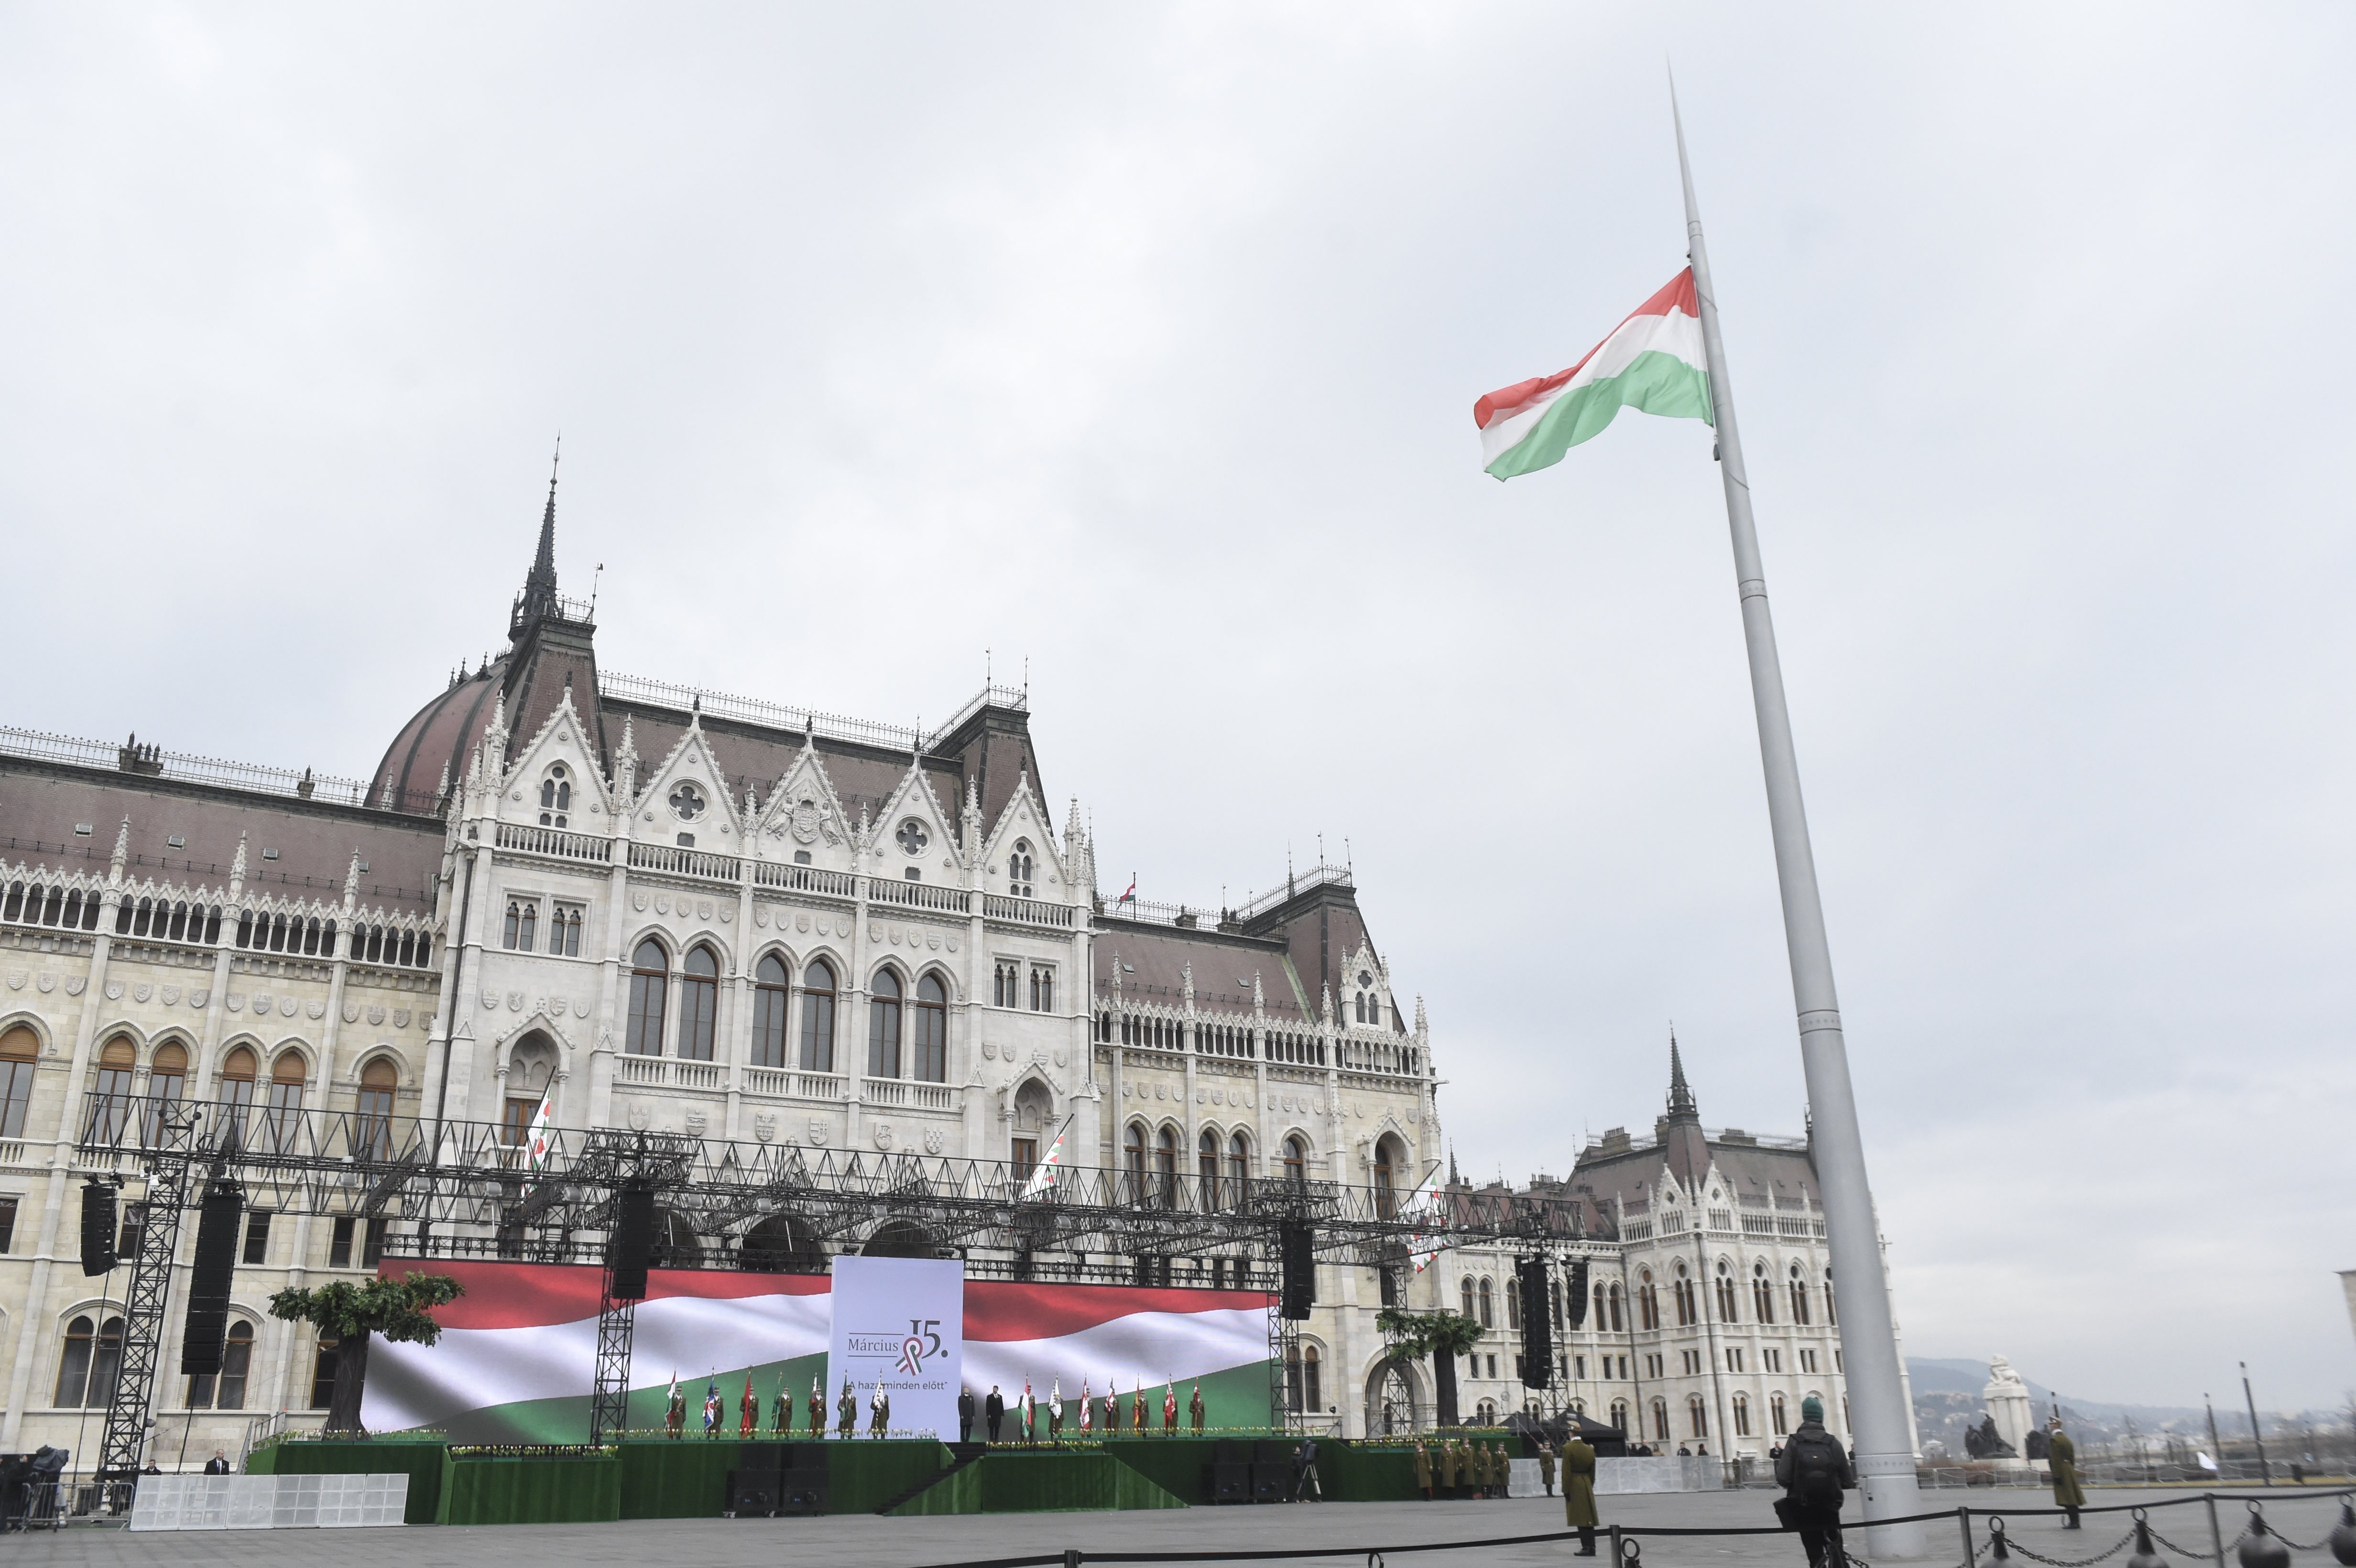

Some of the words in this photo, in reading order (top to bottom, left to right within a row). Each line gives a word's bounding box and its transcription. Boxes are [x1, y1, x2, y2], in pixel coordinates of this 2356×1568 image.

[848, 1338, 898, 1351] Március
[910, 1319, 948, 1359] 15.
[884, 1381, 920, 1390] minden
